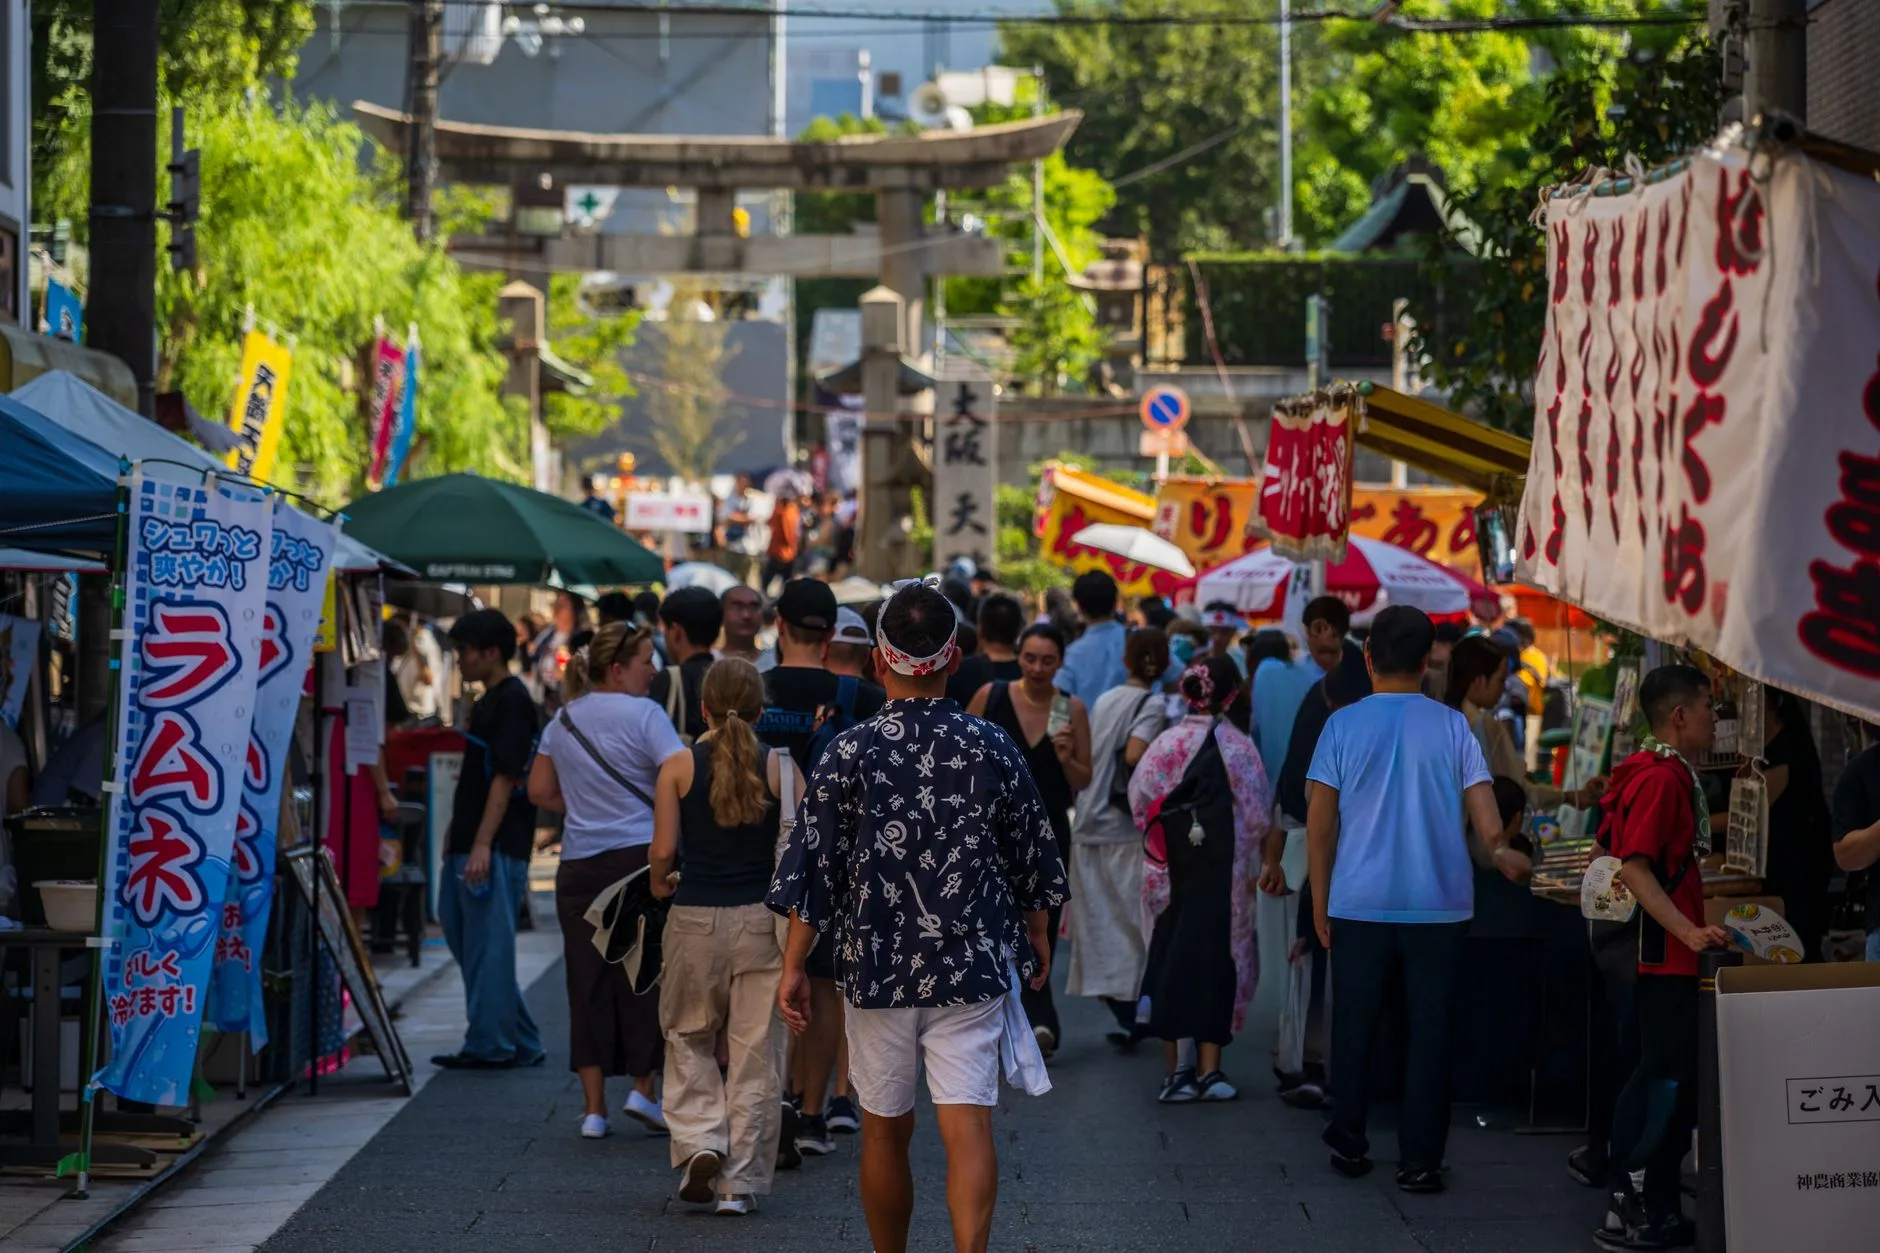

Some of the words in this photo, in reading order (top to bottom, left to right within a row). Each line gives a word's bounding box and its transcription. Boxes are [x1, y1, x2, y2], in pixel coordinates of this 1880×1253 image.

[944, 382, 988, 567] 大阪天
[143, 518, 259, 559] シュワっと
[272, 531, 321, 569] ワっと
[152, 552, 243, 589] 爽やか!
[126, 604, 238, 925] ラムネ
[1800, 1084, 1880, 1112] ごみ入
[1797, 1171, 1880, 1191] 神農商業協
